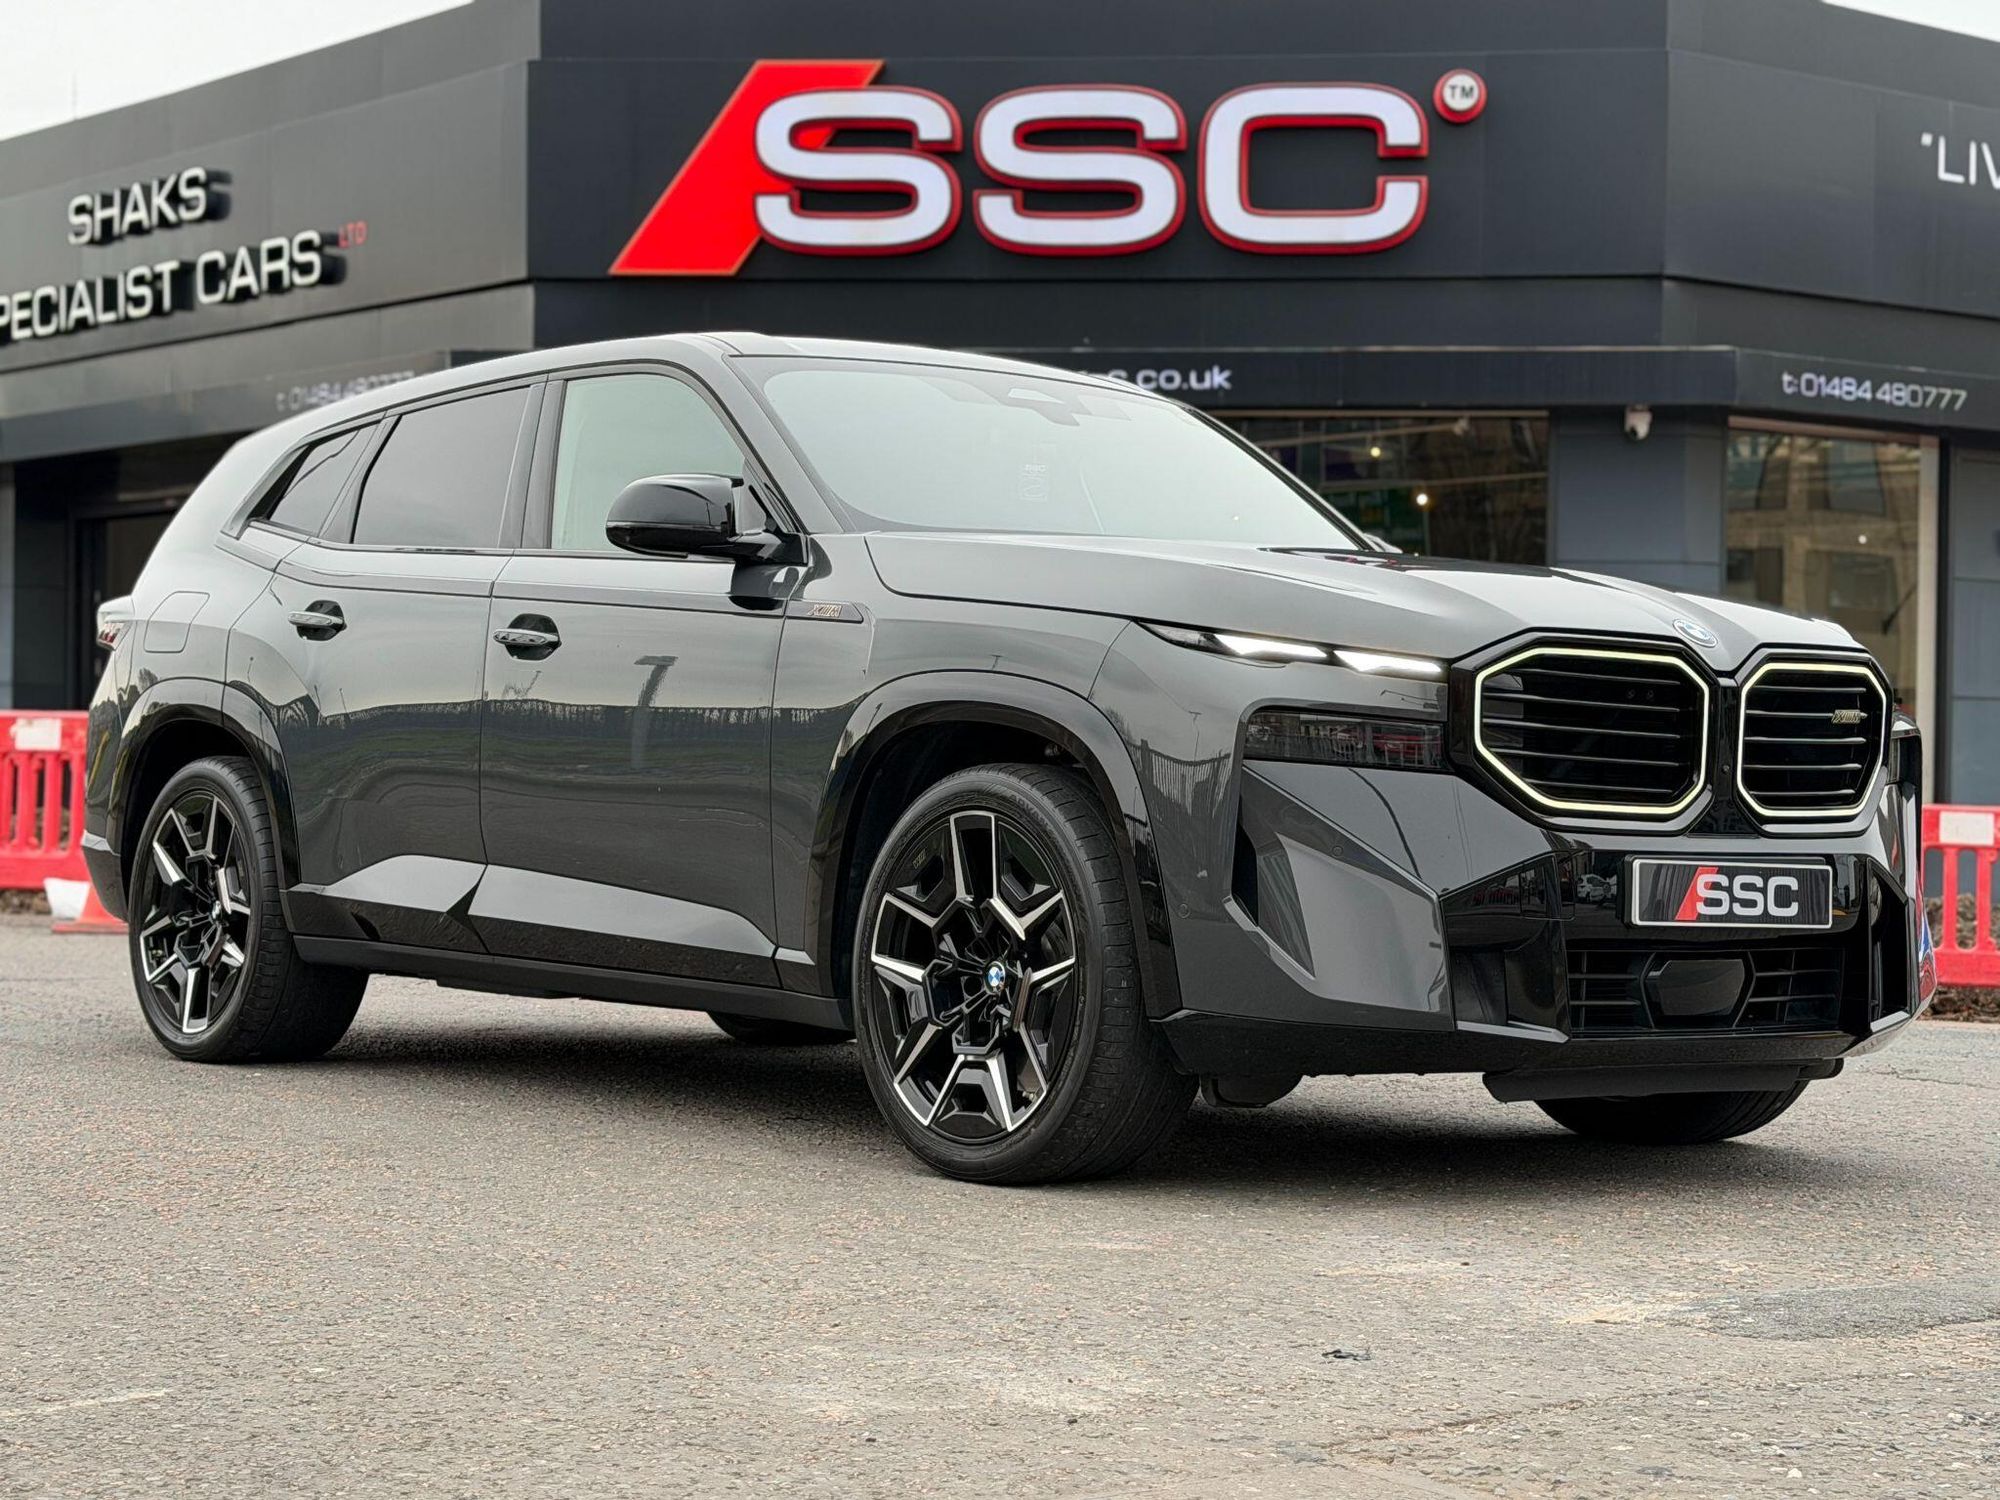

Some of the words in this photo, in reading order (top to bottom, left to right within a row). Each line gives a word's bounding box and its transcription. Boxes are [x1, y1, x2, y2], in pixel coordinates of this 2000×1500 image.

[68, 167, 207, 246] SHAKS
[753, 82, 1428, 254] SSC
[1448, 84, 1474, 99] TM
[0, 258, 180, 340] PECIALIST
[195, 230, 323, 304] CARS
[338, 221, 367, 248] LTD
[1875, 382, 1967, 411] 480777
[1695, 874, 1799, 917] SSC
